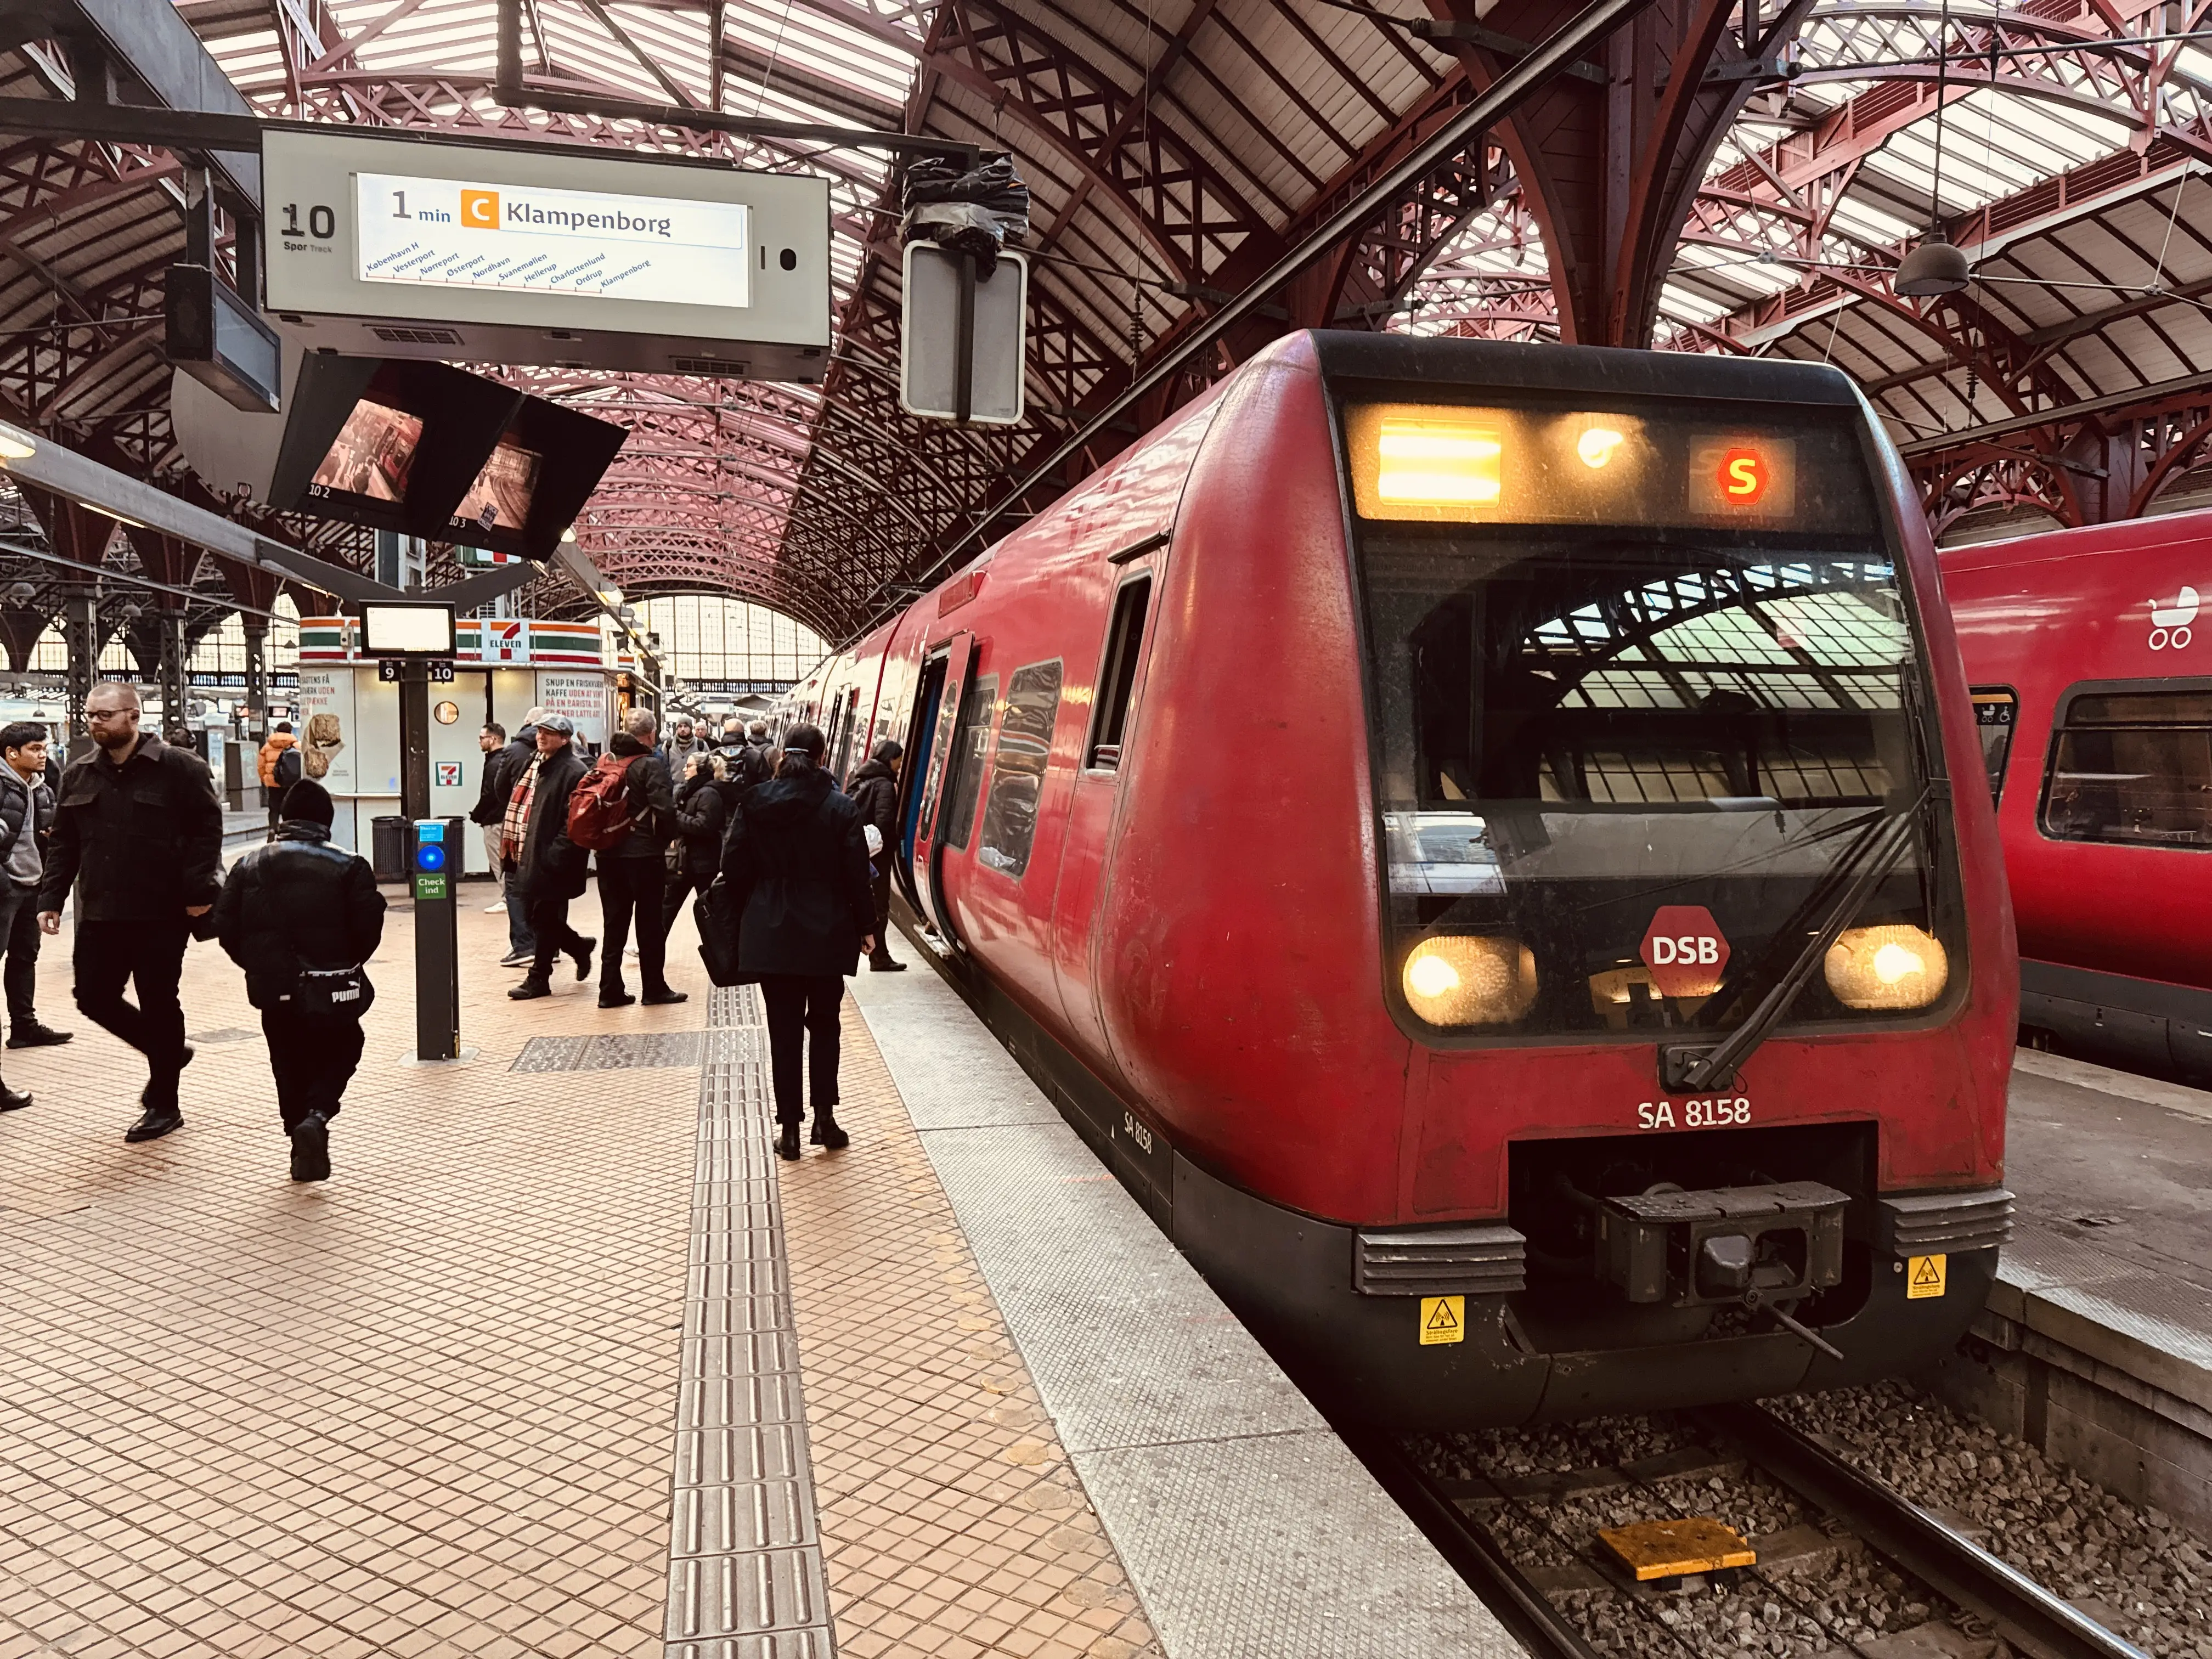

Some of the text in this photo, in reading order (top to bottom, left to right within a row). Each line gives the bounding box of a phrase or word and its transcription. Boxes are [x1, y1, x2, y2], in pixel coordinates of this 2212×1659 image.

[281, 204, 335, 239] 10
[393, 190, 671, 238] 1 min C Klampenborg
[284, 241, 332, 253] Spor Track
[366, 241, 419, 271] København H
[393, 250, 436, 273] Vesterport
[420, 252, 460, 275] Nørreport
[447, 254, 485, 276] Østerport
[472, 256, 511, 279] Nordhavn
[498, 253, 548, 281] Svanemøllen
[550, 252, 606, 284] Charlottenlund
[524, 262, 557, 283] Hellerup
[575, 269, 602, 286] Ordrup
[600, 259, 651, 288] Klampenborg
[1729, 459, 1757, 494] S
[309, 483, 330, 499] 10 2
[449, 515, 466, 528] 10 3
[385, 667, 394, 679] 9
[435, 668, 452, 680] 10
[545, 678, 565, 687] SNUP
[546, 689, 567, 697] KAFFE
[546, 697, 555, 707] PÅ
[576, 709, 592, 718] LATTE
[419, 878, 445, 886] Check
[425, 886, 439, 894] ind
[1652, 936, 1719, 965] DSB
[332, 988, 360, 1003] PUMA
[1638, 1097, 1751, 1128] SA 8158
[1124, 1111, 1152, 1155] SA 8158
